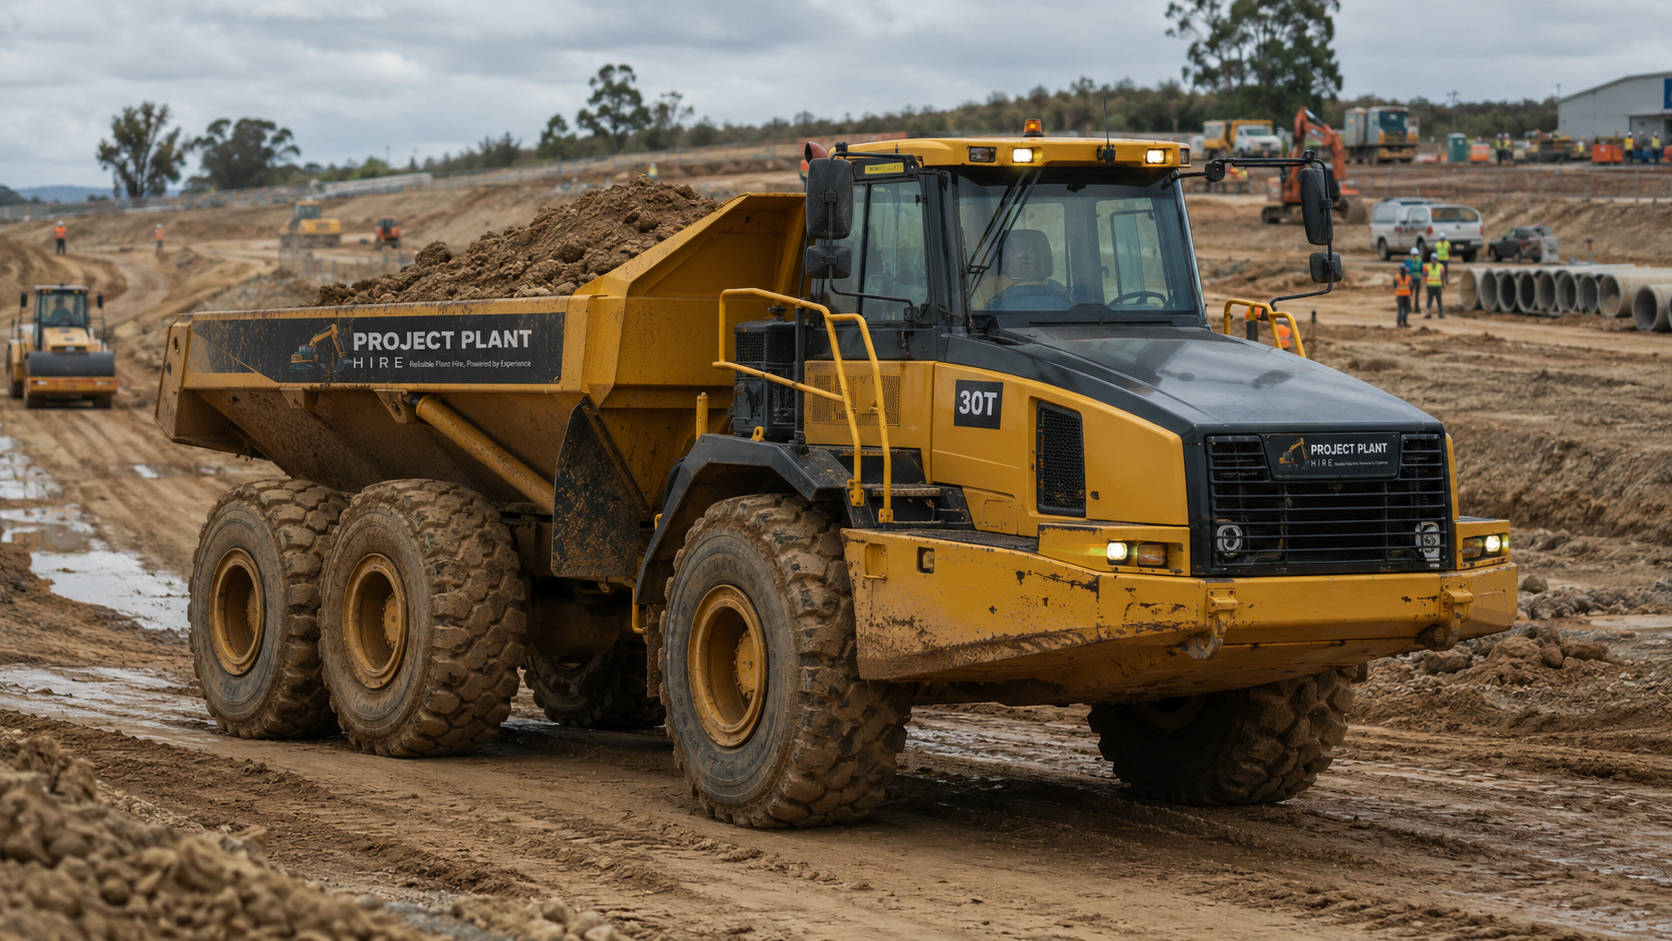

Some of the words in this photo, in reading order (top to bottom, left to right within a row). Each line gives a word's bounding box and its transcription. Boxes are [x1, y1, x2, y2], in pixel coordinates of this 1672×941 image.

[353, 331, 454, 351] PROJECT
[461, 330, 532, 349] PLANT
[353, 357, 403, 368] HIRE
[492, 360, 500, 369] by
[959, 390, 997, 416] 30T
[1311, 444, 1355, 455] PROJECT
[1357, 443, 1388, 454] PLANT
[1310, 459, 1333, 467] HIRE
